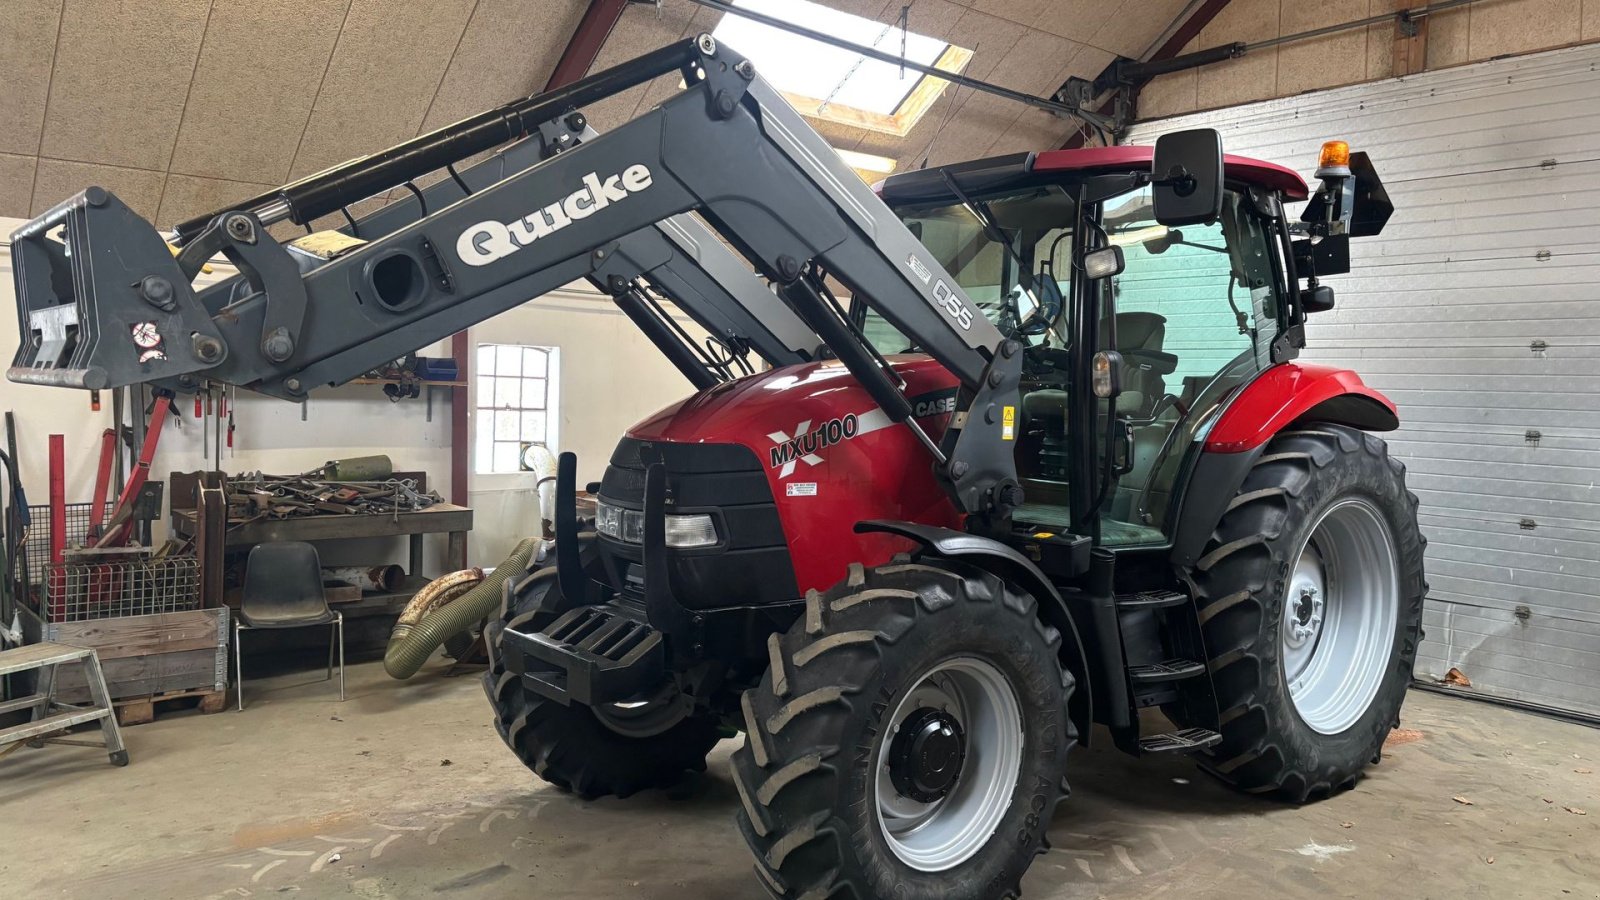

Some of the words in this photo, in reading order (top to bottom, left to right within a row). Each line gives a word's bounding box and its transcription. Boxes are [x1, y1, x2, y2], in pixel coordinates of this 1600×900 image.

[456, 163, 653, 267] Quicke
[931, 277, 975, 332] Q55
[915, 396, 955, 418] CASE
[769, 411, 860, 469] MXU100
